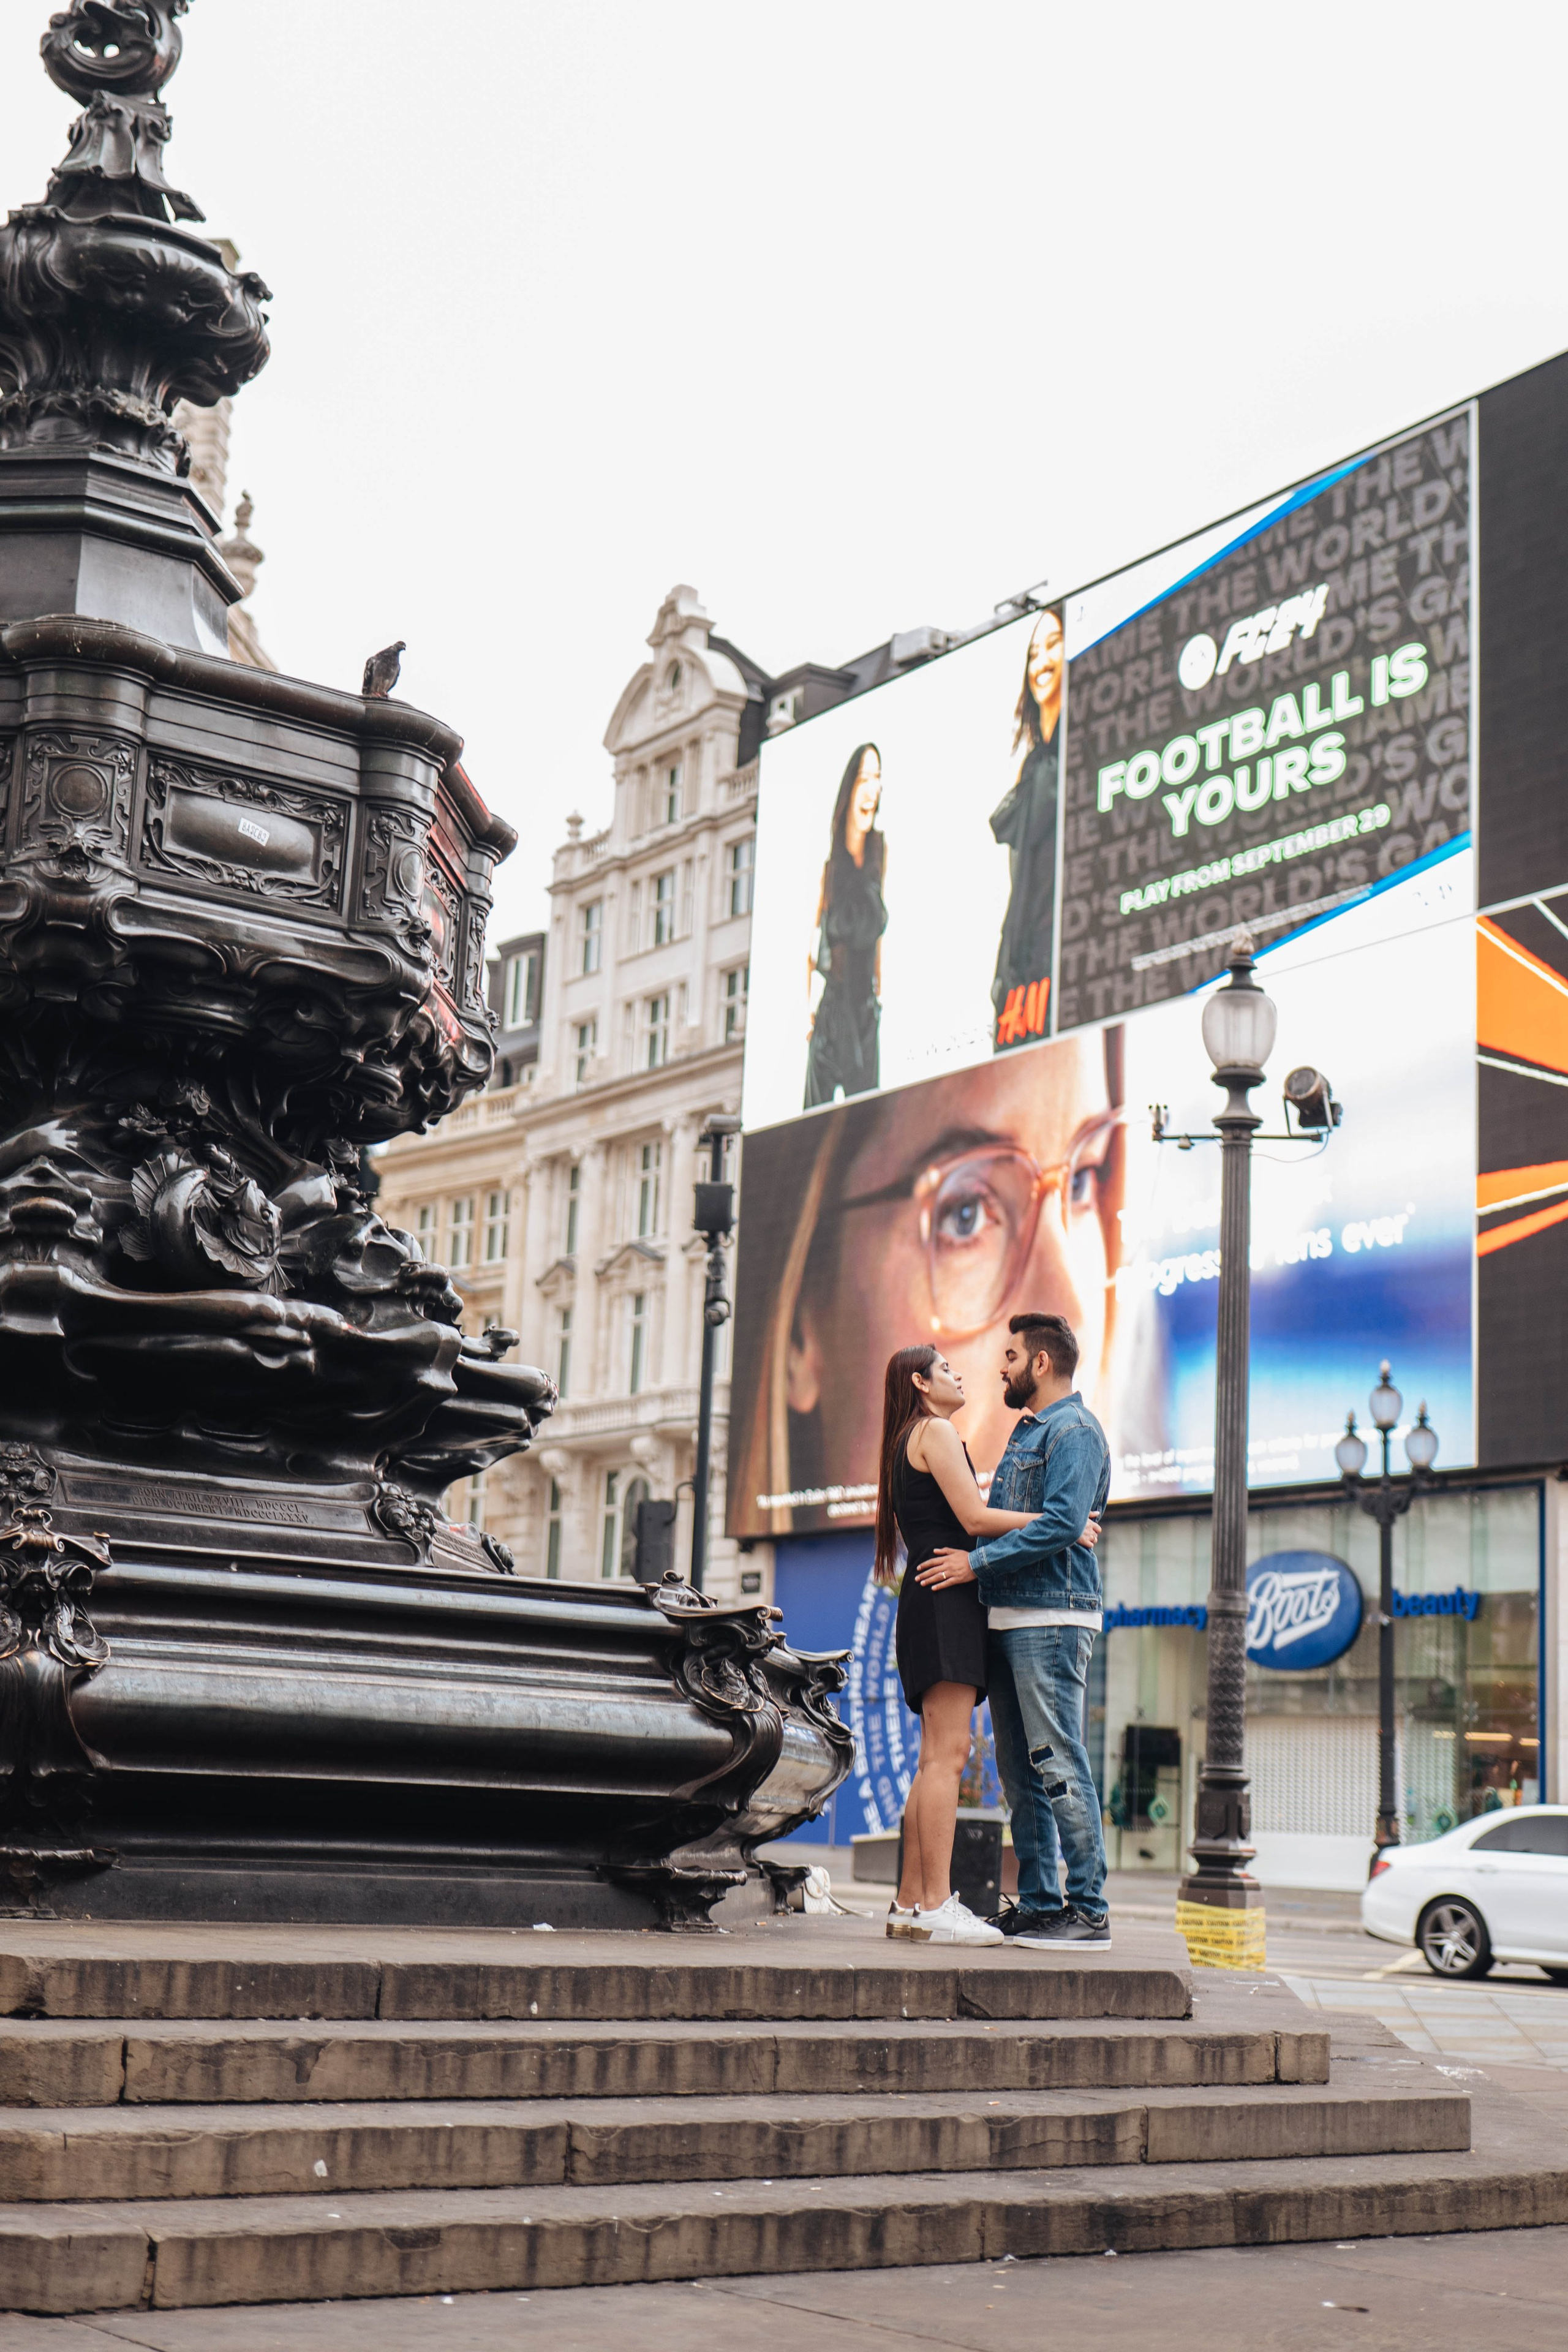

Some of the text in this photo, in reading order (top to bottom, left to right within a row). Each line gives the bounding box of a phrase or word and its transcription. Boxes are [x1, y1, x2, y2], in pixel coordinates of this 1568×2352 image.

[1098, 671, 1364, 813] FOOTBALL
[1371, 643, 1428, 707] IS
[1162, 731, 1346, 837] YOURS
[1120, 878, 1170, 915] PLAY
[1170, 858, 1231, 898] FROM
[1231, 814, 1359, 876] SEPTEMBER
[1357, 803, 1391, 834] 29
[996, 976, 1050, 1045] H&M
[166, 1500, 217, 1515] OCTOBER
[172, 1491, 201, 1504] APRIL
[1102, 1600, 1207, 1633] pharmacy
[1246, 1567, 1341, 1651] Boots
[1392, 1585, 1482, 1621] beauty
[865, 1602, 891, 1702] WORLD
[867, 1713, 886, 1774] THE
[883, 1677, 906, 1774] THERE
